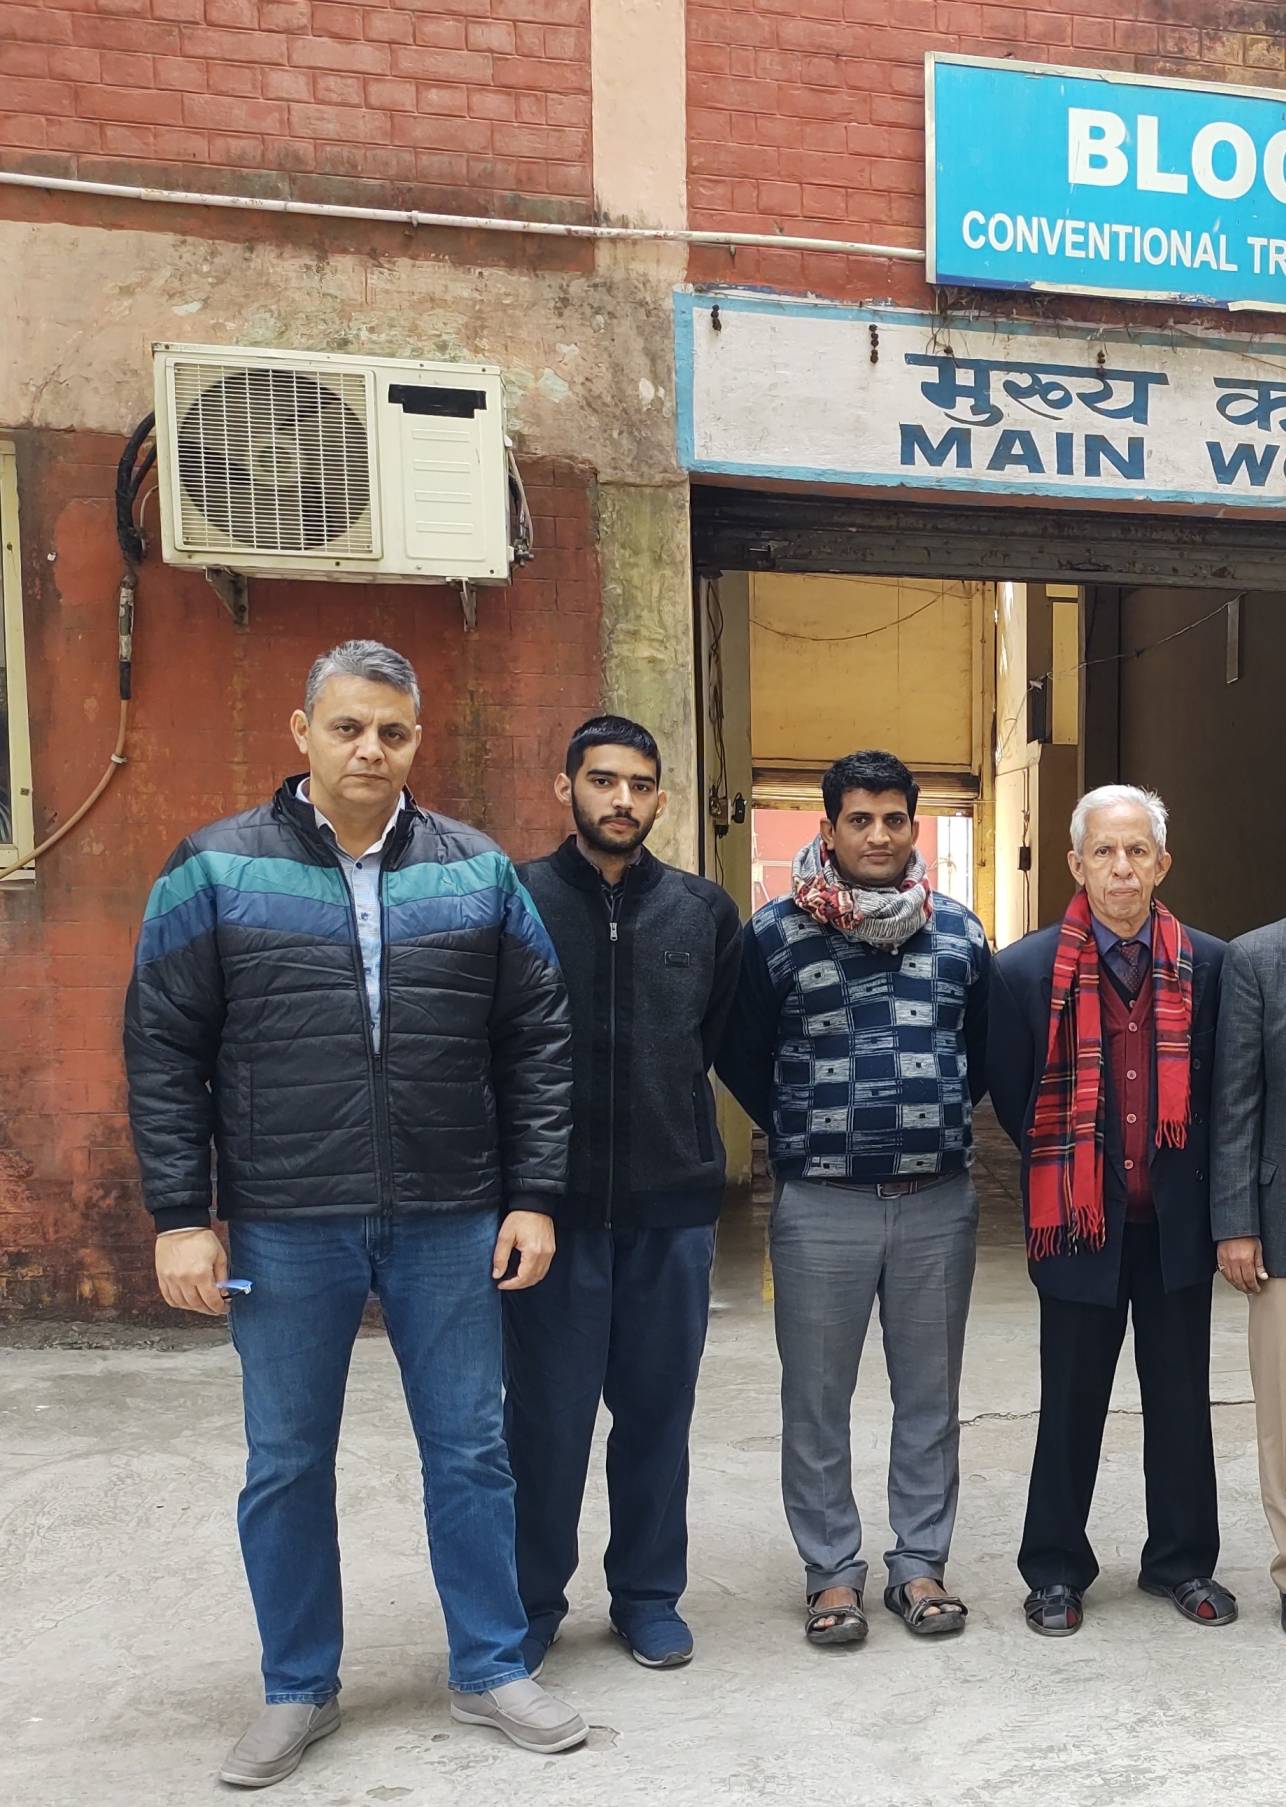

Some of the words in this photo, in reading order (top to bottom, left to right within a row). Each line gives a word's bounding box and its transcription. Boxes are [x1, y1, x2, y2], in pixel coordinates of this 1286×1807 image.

[961, 210, 1239, 272] CONVENTIONAL
[905, 353, 1170, 426] मुख्य
[899, 422, 1145, 480] MAIN
